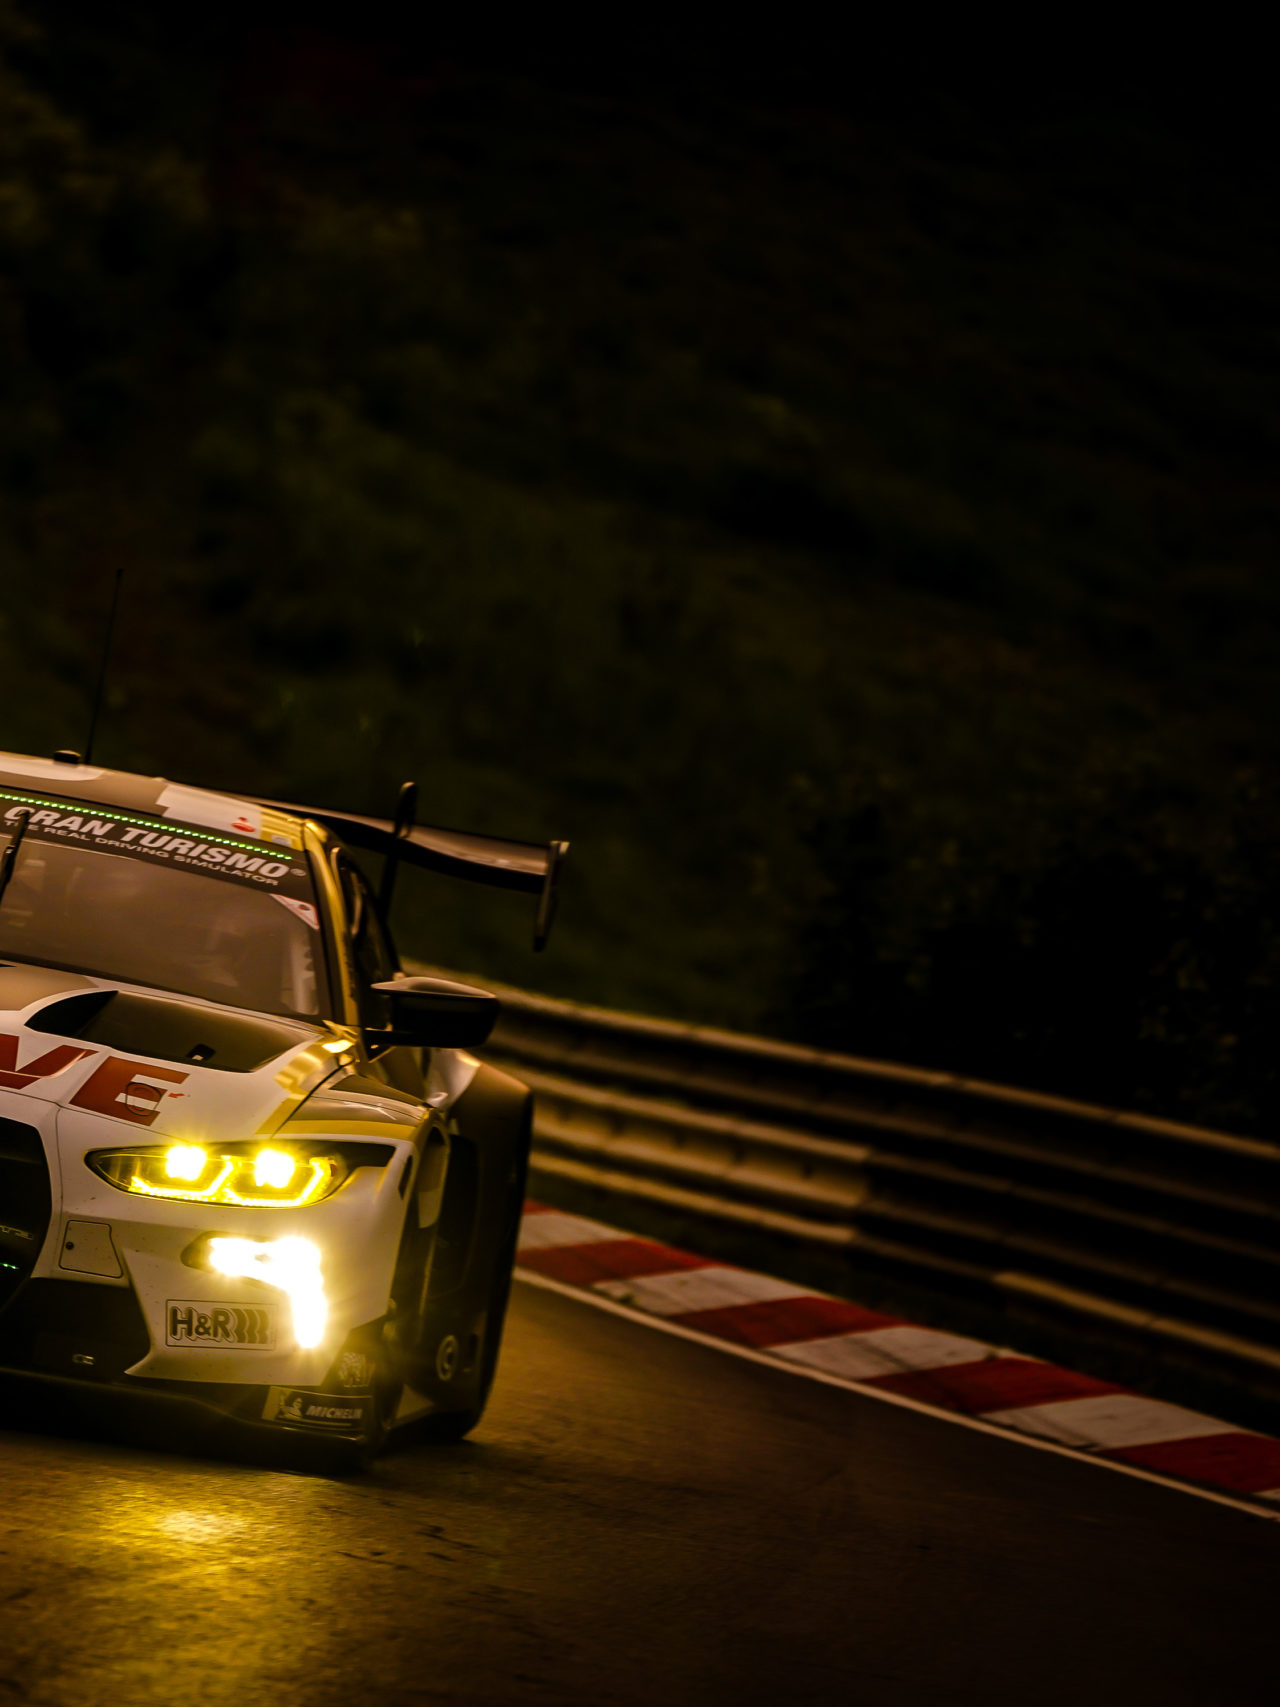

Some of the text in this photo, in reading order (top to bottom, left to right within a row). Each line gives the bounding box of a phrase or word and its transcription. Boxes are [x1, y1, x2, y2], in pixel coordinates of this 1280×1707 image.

[4, 806, 293, 879] GRAN TURISMO
[43, 827, 95, 842] REAL
[95, 837, 172, 859] DRIVING
[173, 855, 280, 886] SIMULATOR
[171, 1306, 232, 1340] H&R
[305, 1405, 364, 1420] MICHELIN
